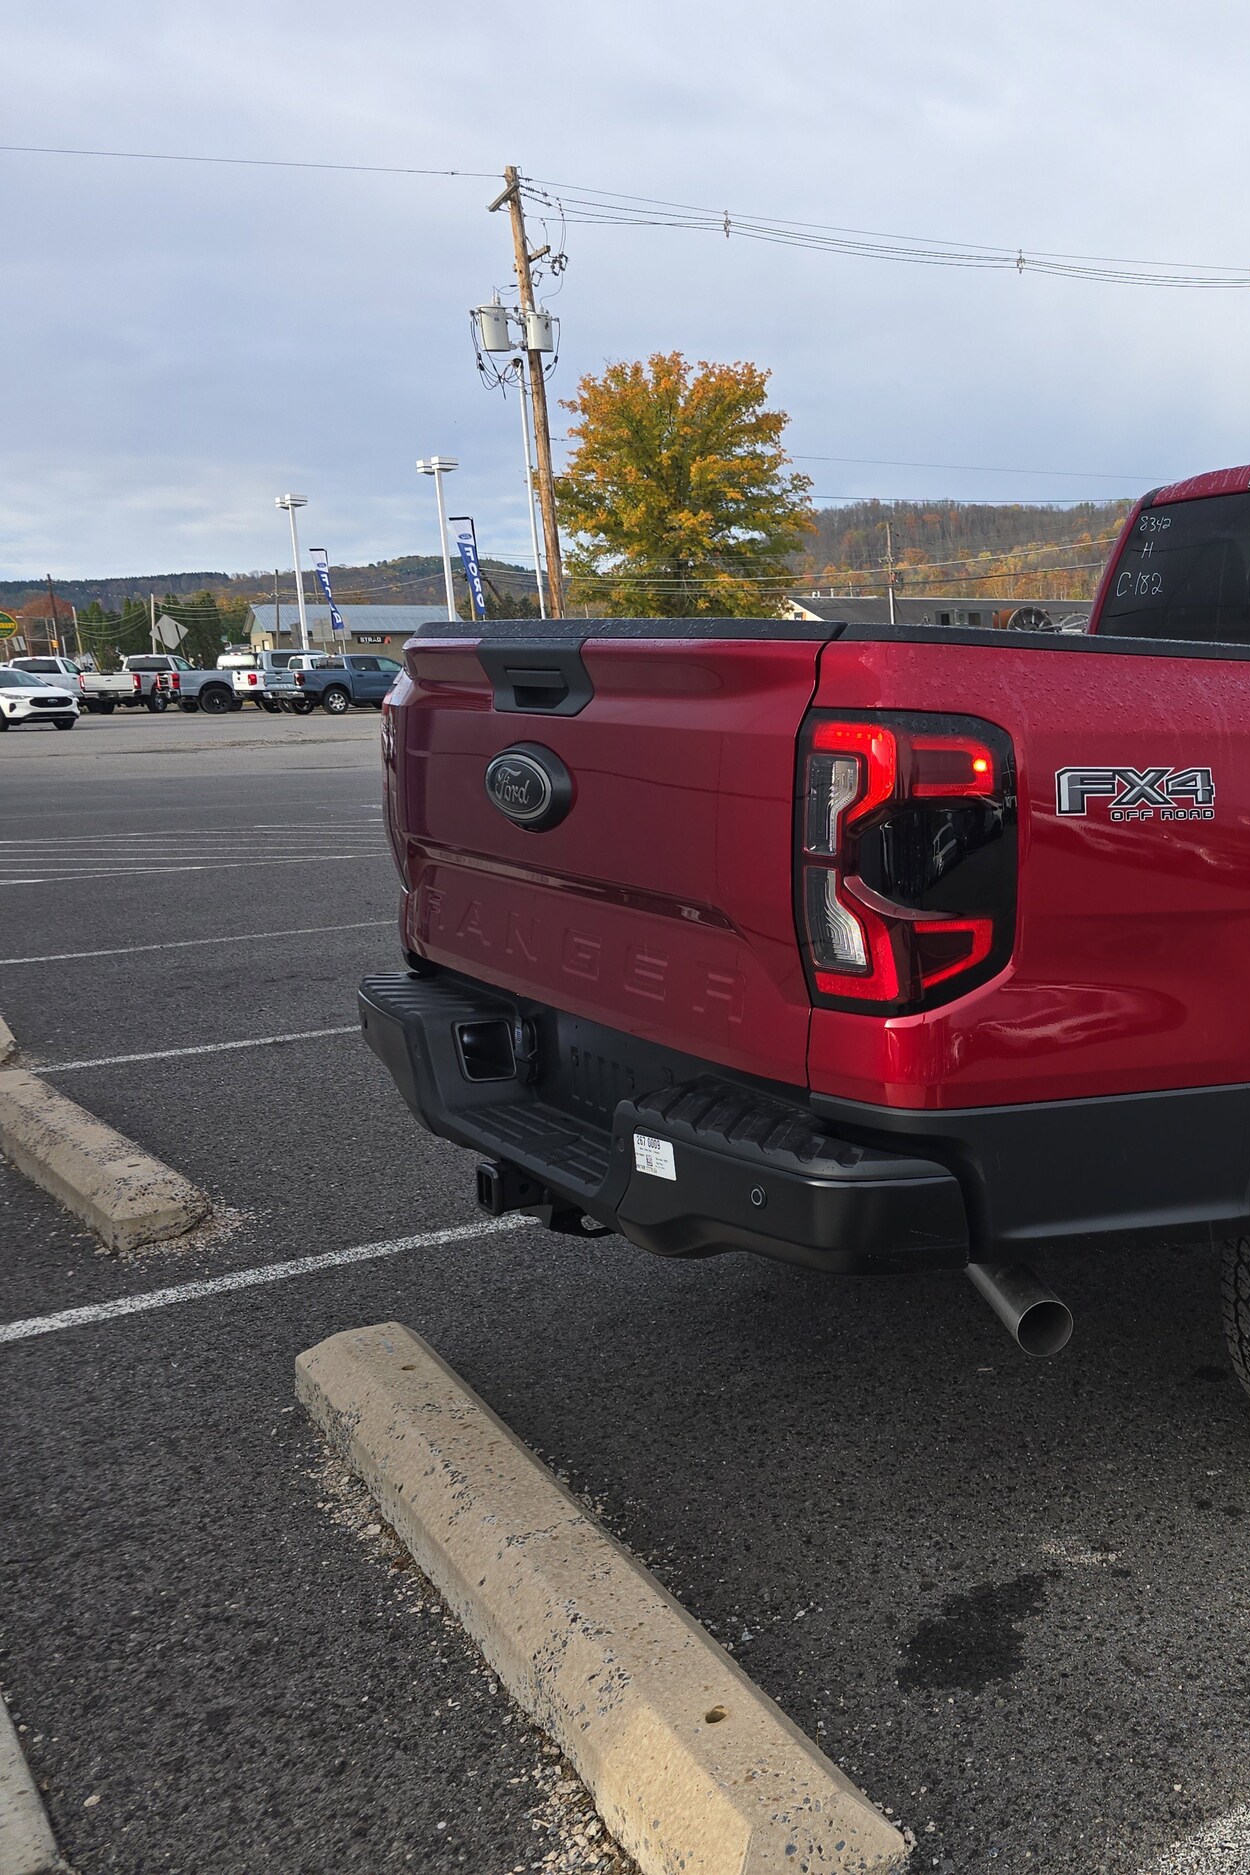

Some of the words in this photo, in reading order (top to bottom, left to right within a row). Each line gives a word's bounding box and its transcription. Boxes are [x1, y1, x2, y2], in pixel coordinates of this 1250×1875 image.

[1138, 515, 1172, 533] 8342
[1140, 542, 1154, 559] H
[464, 547, 485, 608] FORD
[1054, 766, 1216, 817] FX4
[1110, 809, 1153, 822] OFF
[1160, 808, 1215, 821] ROAD
